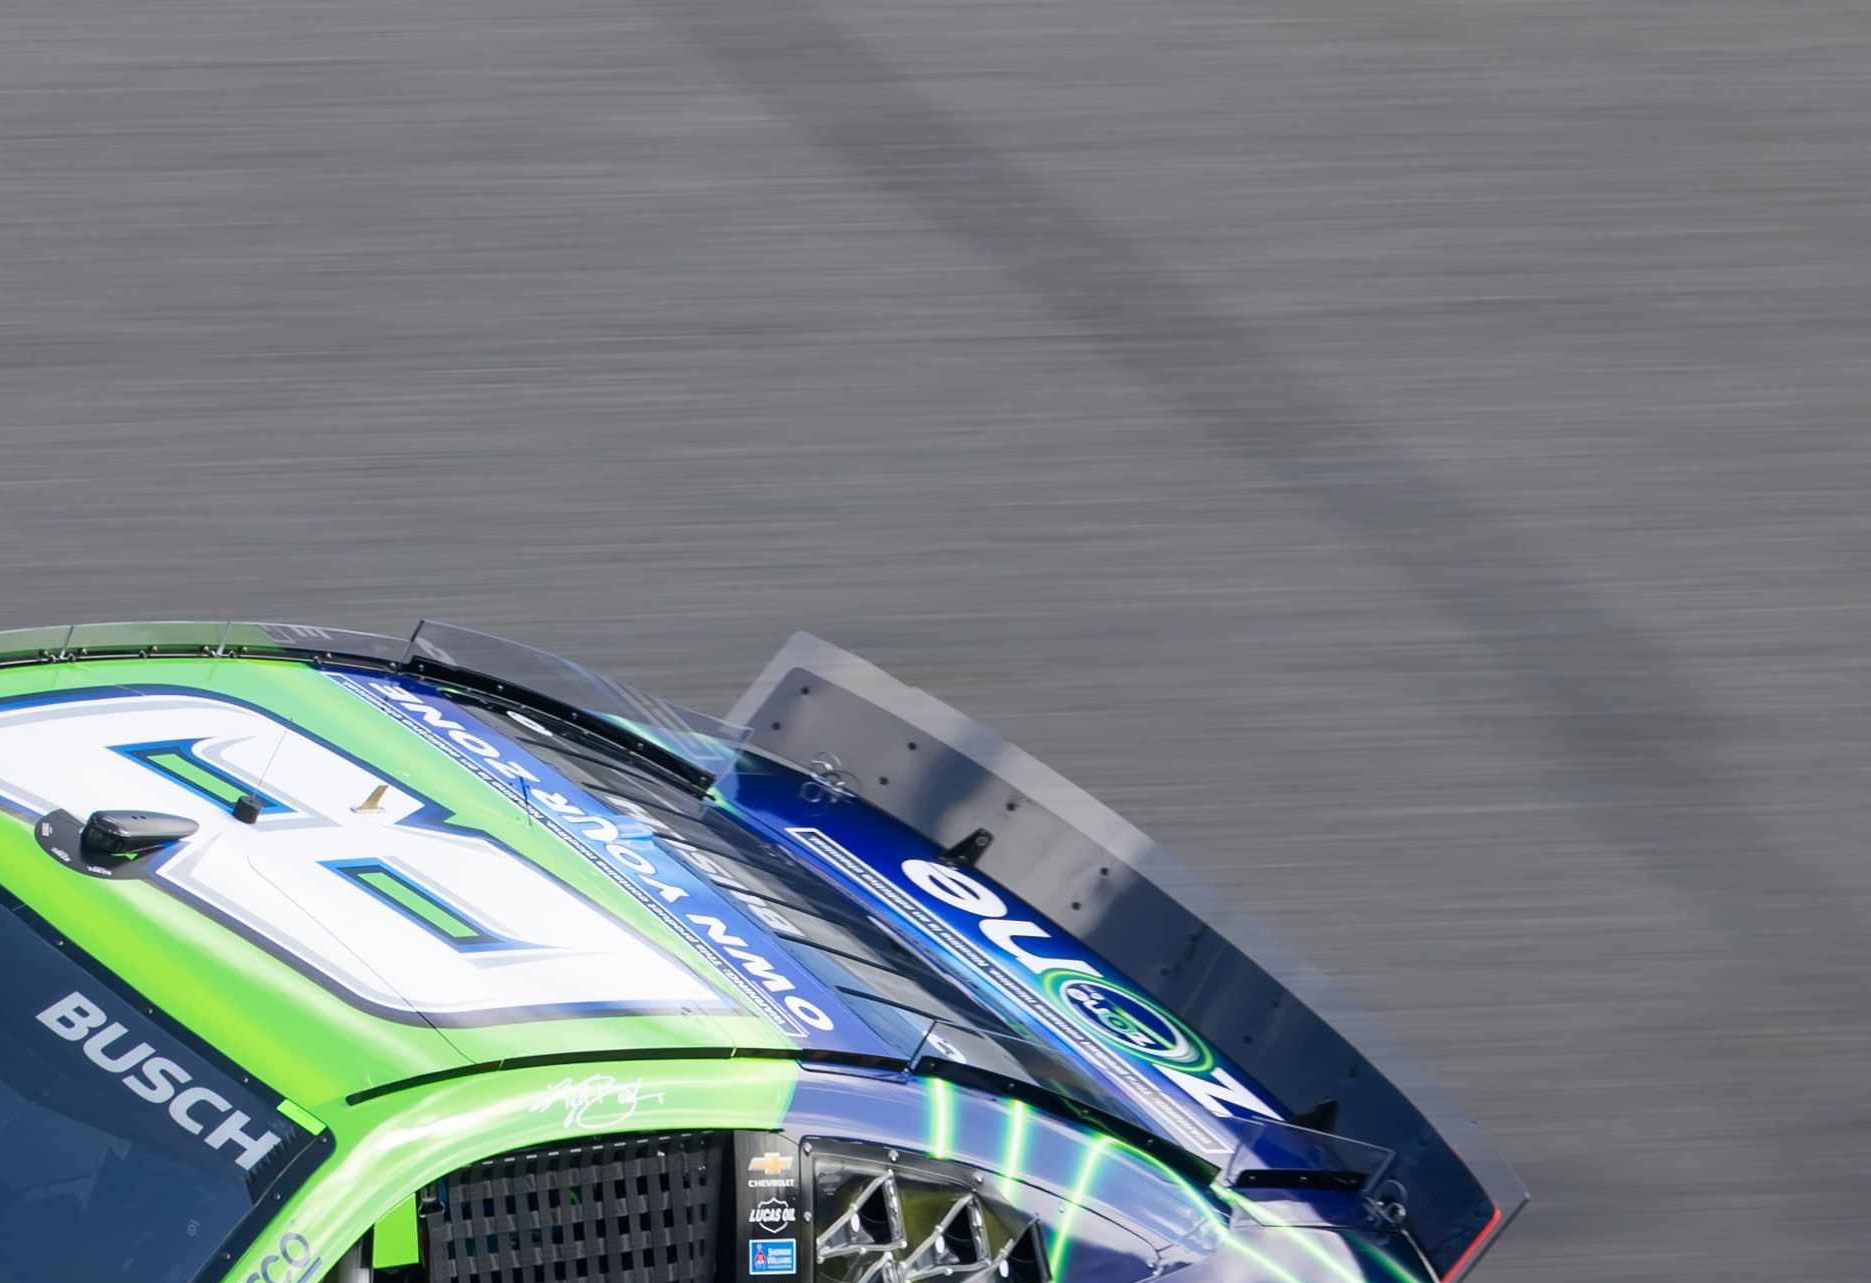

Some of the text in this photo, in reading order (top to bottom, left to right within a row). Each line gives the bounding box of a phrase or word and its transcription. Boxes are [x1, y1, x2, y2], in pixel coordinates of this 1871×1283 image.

[368, 682, 834, 1031] OWN YOUR ZONE
[34, 990, 282, 1171] BUSCH
[748, 1178, 795, 1188] CHEVROLET
[749, 1207, 797, 1223] LUCAS OIL
